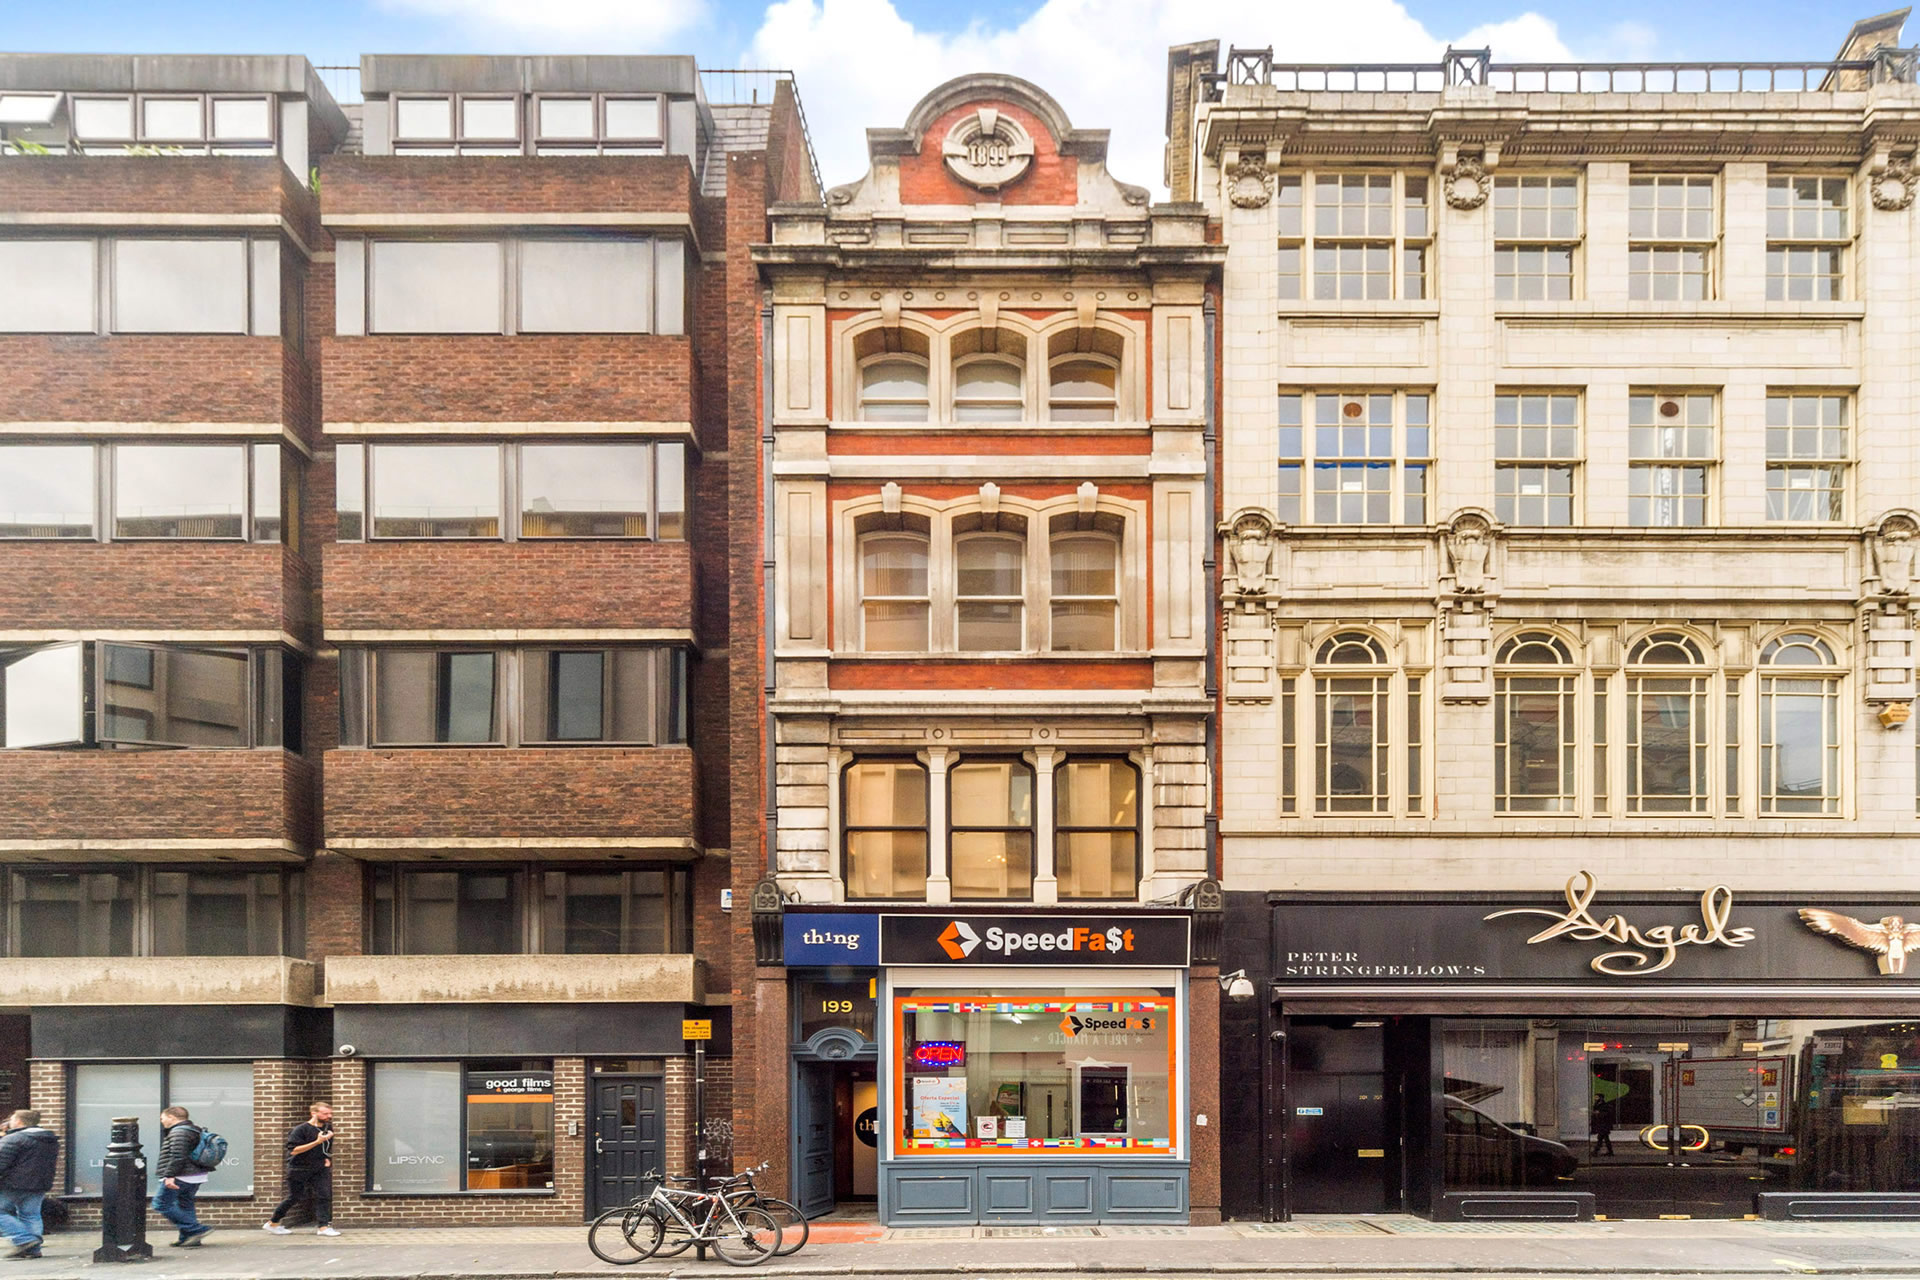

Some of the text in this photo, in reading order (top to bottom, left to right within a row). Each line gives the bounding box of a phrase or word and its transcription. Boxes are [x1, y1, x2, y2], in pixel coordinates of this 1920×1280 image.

[968, 144, 1008, 166] 1899
[1482, 869, 1756, 976] Angels
[986, 926, 1135, 956] SpeedFa$t
[1287, 952, 1359, 962] PETER
[1286, 965, 1486, 975] STRINGFELLOW'S
[822, 1000, 853, 1013] 199
[1085, 1017, 1156, 1031] SpeedFa$t
[915, 1047, 963, 1061] OPEN
[486, 1078, 551, 1089] good films
[389, 1155, 445, 1165] LIPSYNC
